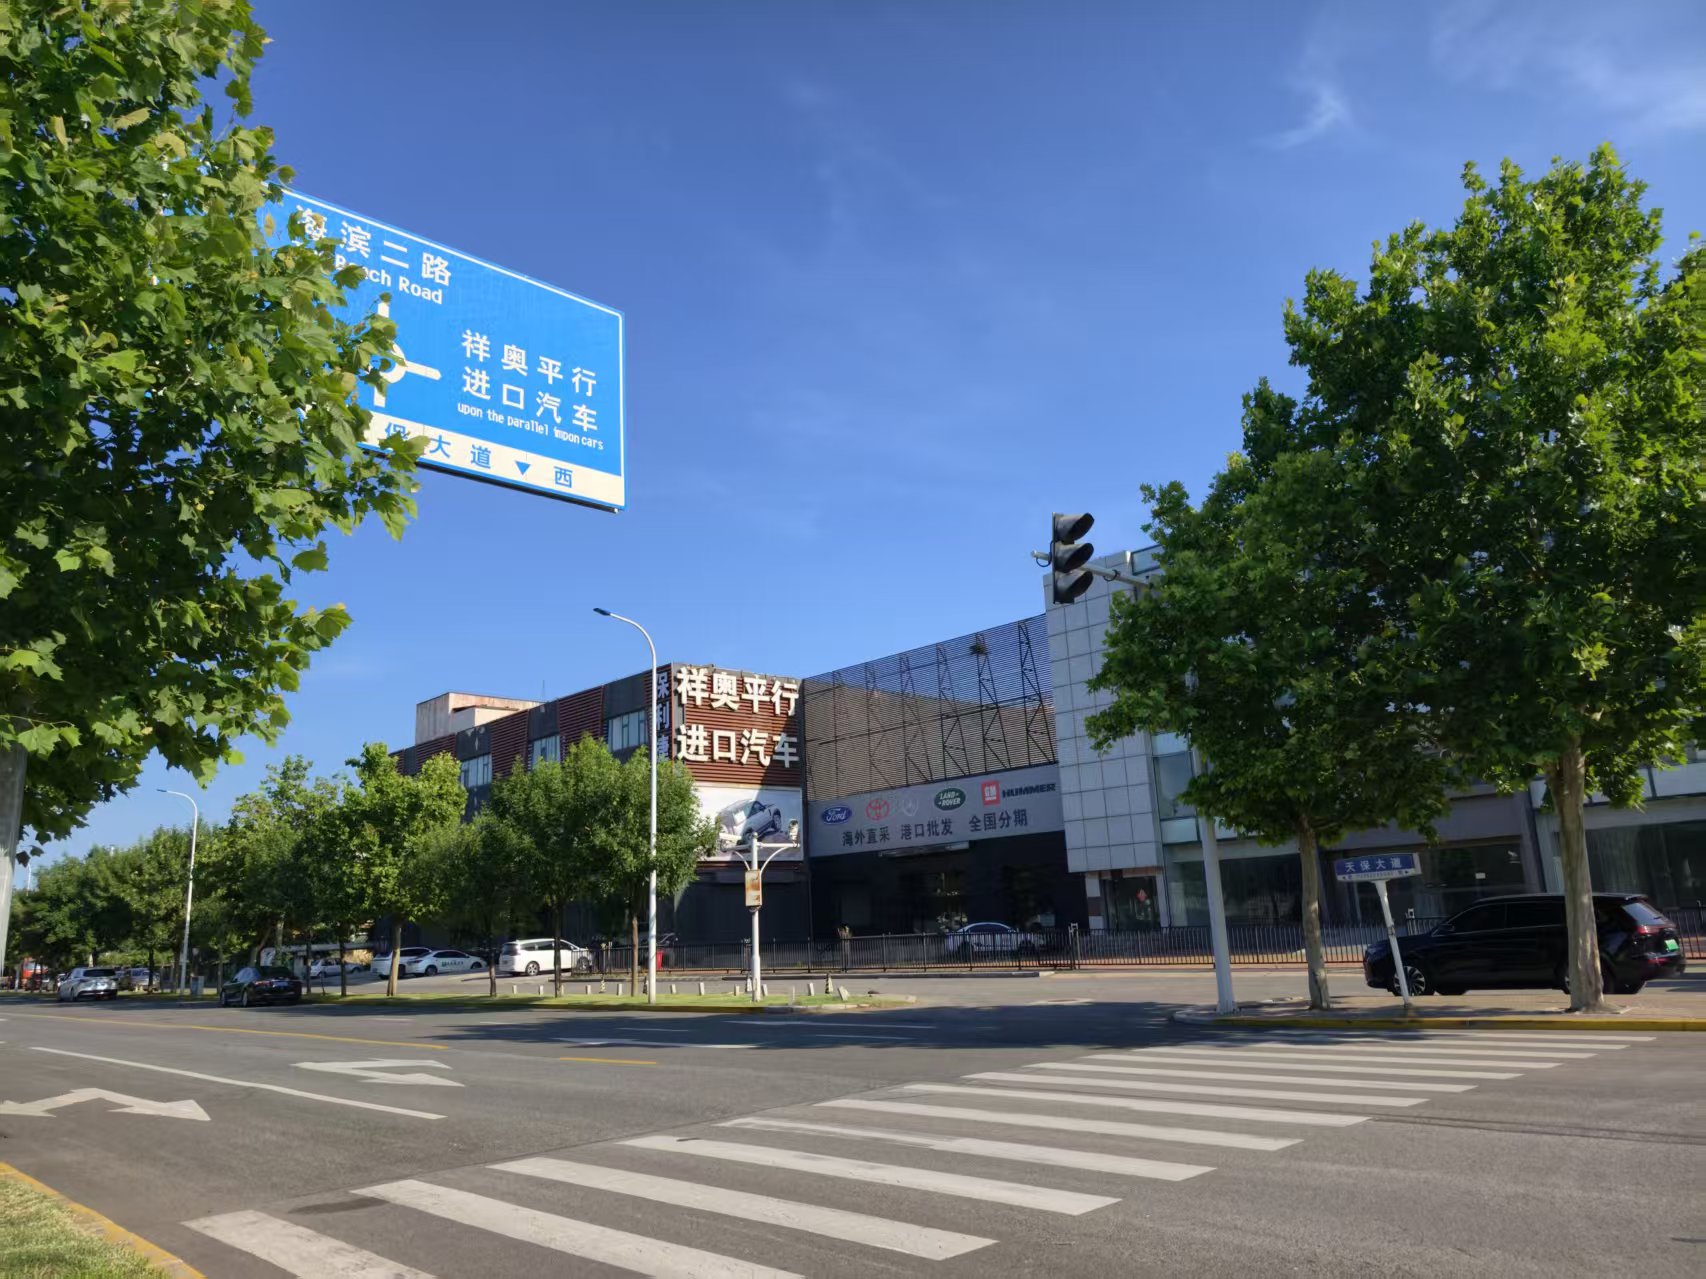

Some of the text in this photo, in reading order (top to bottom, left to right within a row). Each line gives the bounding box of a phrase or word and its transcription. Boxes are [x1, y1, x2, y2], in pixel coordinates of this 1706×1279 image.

[335, 254, 443, 304] Bch Road
[462, 329, 597, 397] 祥奥平行
[462, 366, 598, 432] 进口汽车
[458, 402, 483, 418] upon
[486, 409, 505, 424] the
[507, 415, 549, 436] parallel
[581, 437, 604, 450] cars
[554, 466, 573, 488] 西
[676, 667, 799, 716] 祥奥平行
[677, 724, 800, 768] 进口汽车
[939, 791, 956, 800] LAND
[941, 797, 961, 807] ROVER
[1002, 783, 1057, 798] HUMMER
[826, 808, 847, 822] Ford
[842, 808, 1028, 847] 海外直采 港口批发 全国分期
[1344, 857, 1402, 873] 天保大道
